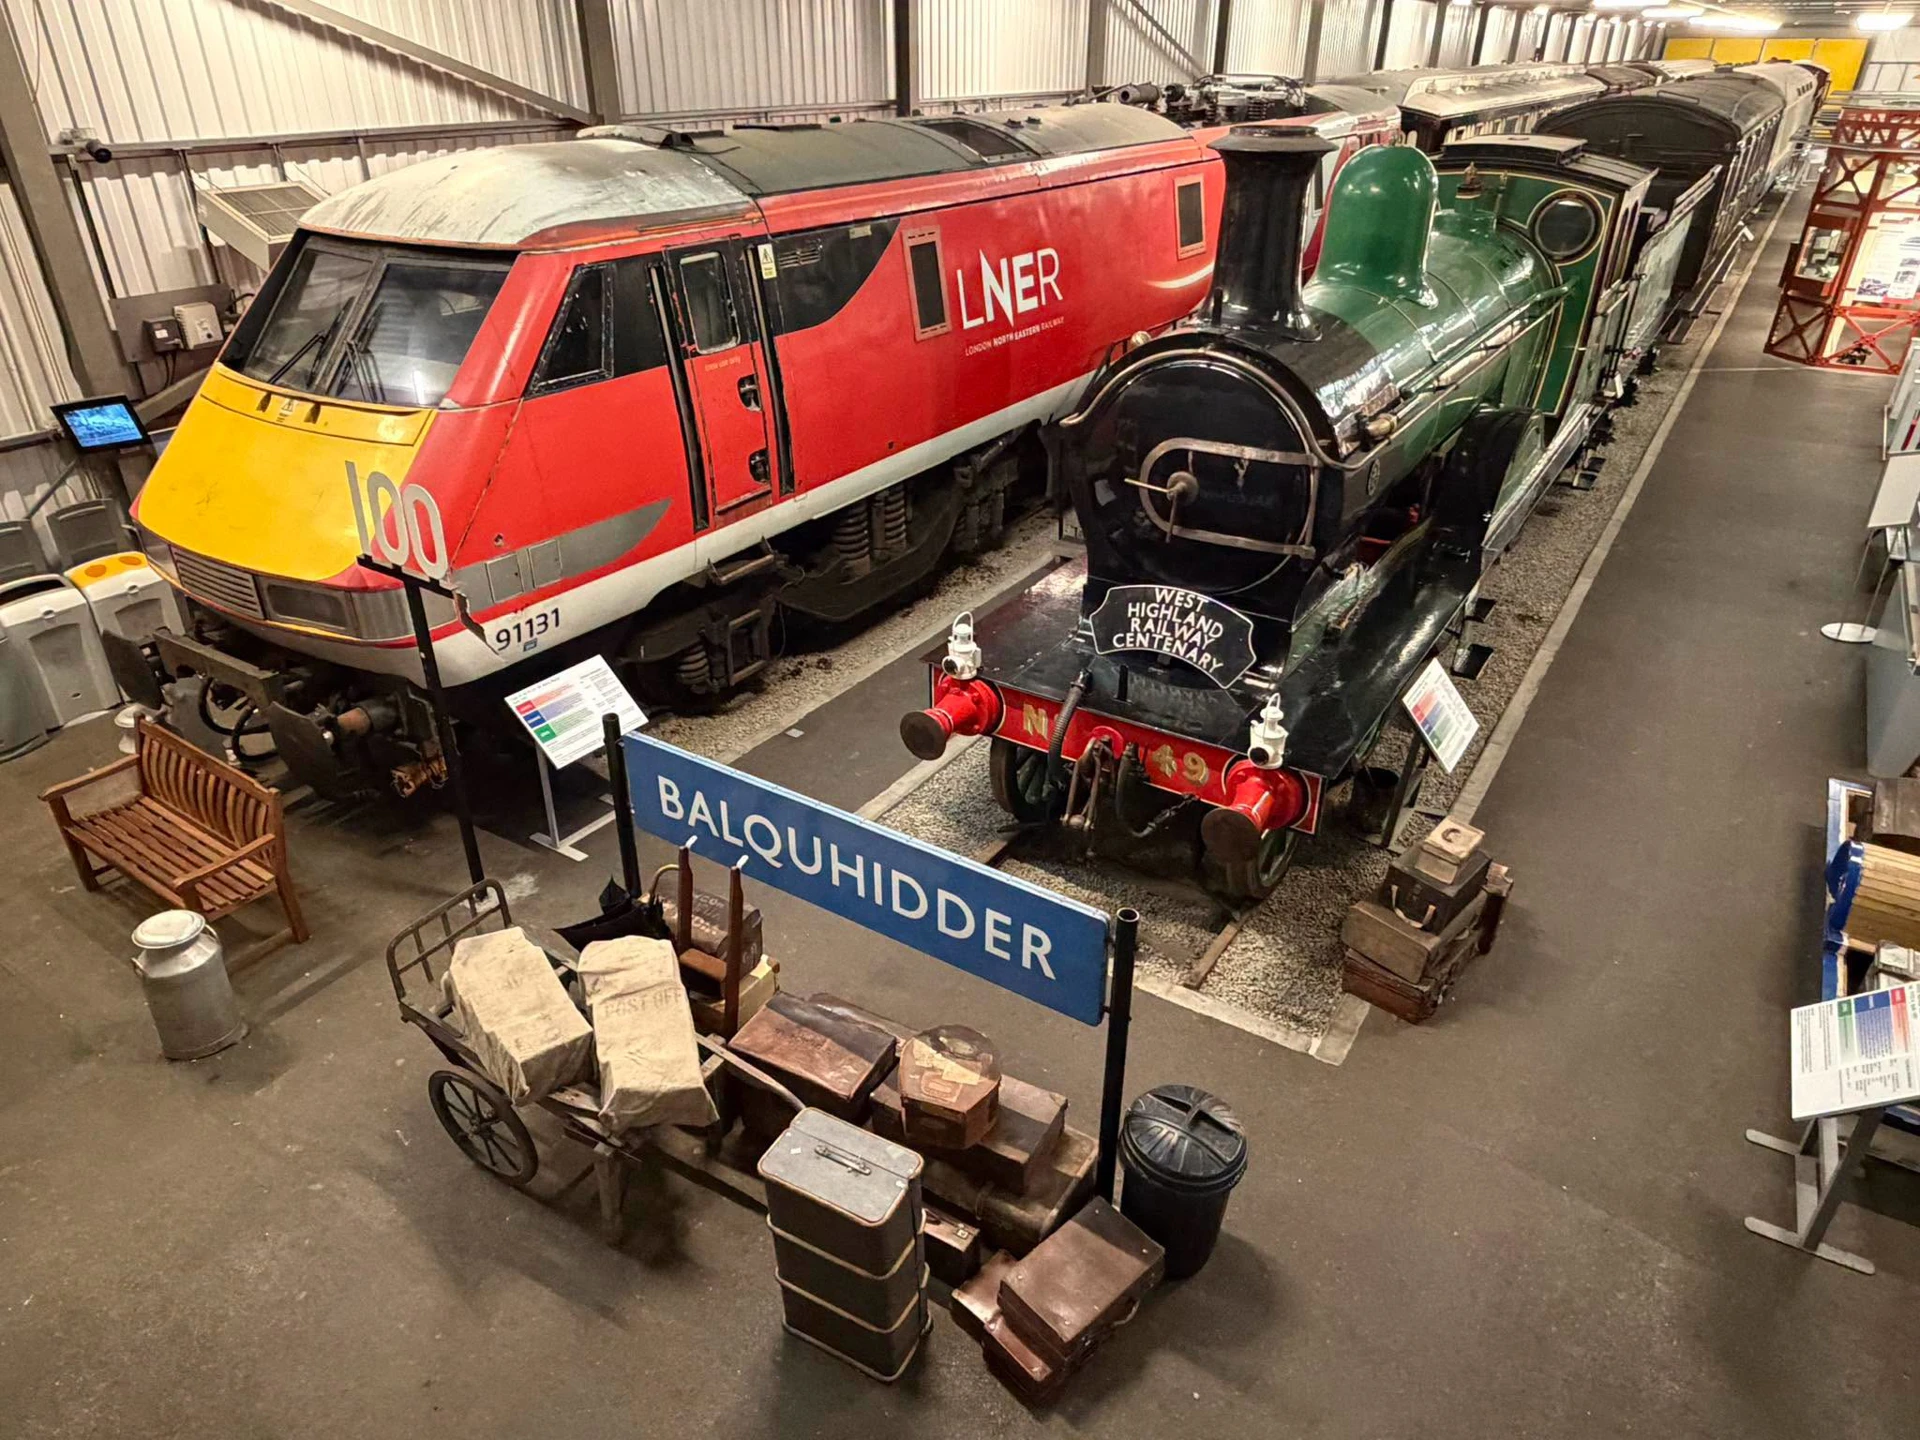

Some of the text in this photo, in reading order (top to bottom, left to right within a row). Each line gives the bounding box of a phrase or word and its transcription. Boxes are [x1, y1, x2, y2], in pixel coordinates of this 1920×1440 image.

[957, 247, 1064, 330] LNER
[965, 316, 1065, 357] LONDON NORTH EASTERN RAILWAY
[345, 460, 448, 579] 100
[1127, 602, 1224, 639] HIGHLAND
[1155, 587, 1209, 612] WEST
[495, 607, 560, 652] 91131
[1130, 618, 1216, 650] RAILWAY
[1112, 632, 1224, 674] CENTENARY
[1153, 744, 1209, 786] 49
[657, 774, 1057, 980] BALQUHIDDER
[604, 994, 647, 1018] POST
